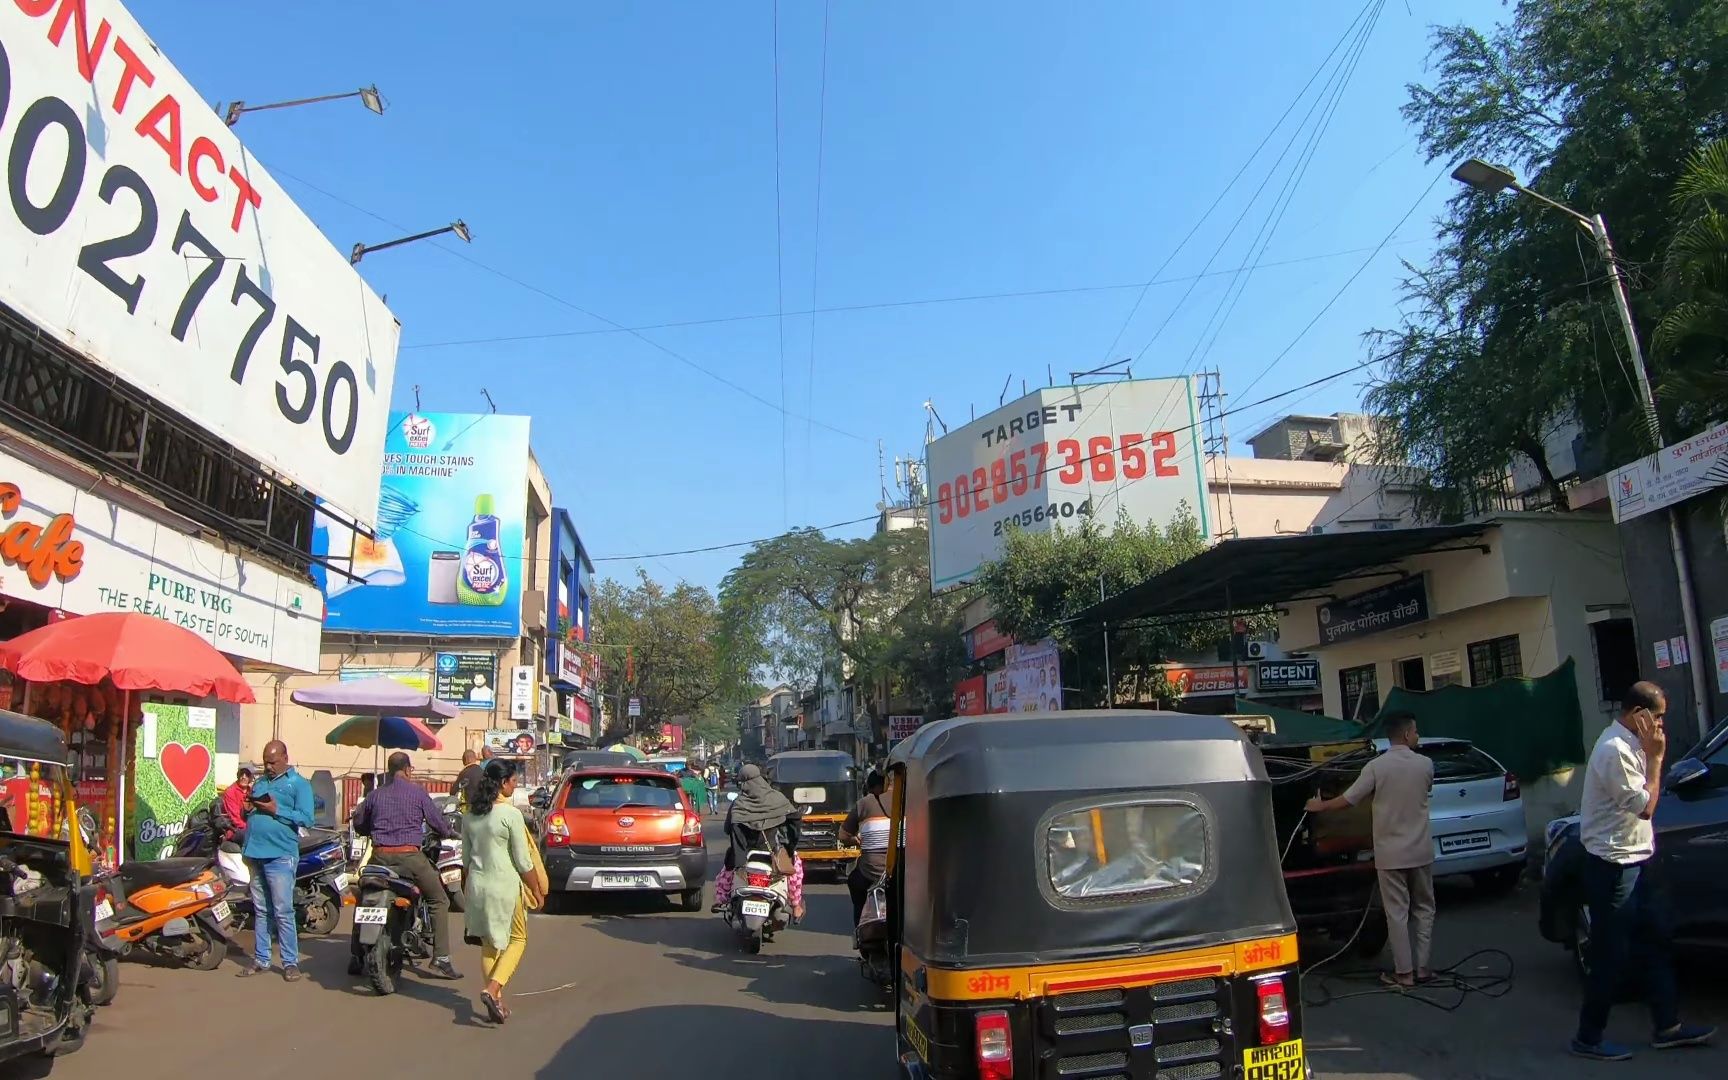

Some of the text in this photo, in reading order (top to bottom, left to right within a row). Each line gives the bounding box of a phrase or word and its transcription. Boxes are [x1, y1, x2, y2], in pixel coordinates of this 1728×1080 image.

[0, 38, 358, 455] 027750
[411, 425, 430, 436] Surf
[982, 403, 1082, 448] TARGET
[396, 466, 406, 474] IN
[405, 454, 437, 465] TOUGH
[440, 456, 474, 466] STAINS
[938, 431, 1180, 525] 9028573652
[473, 564, 493, 575] Surf
[149, 572, 232, 616] PURE VEG
[98, 587, 268, 648] THE REAL TASTE OF SOUTH
[1357, 610, 1390, 629] पोलिस
[1392, 599, 1419, 619] चौकी
[1261, 665, 1315, 680] DECENT
[1192, 680, 1244, 691] ICICI Bak
